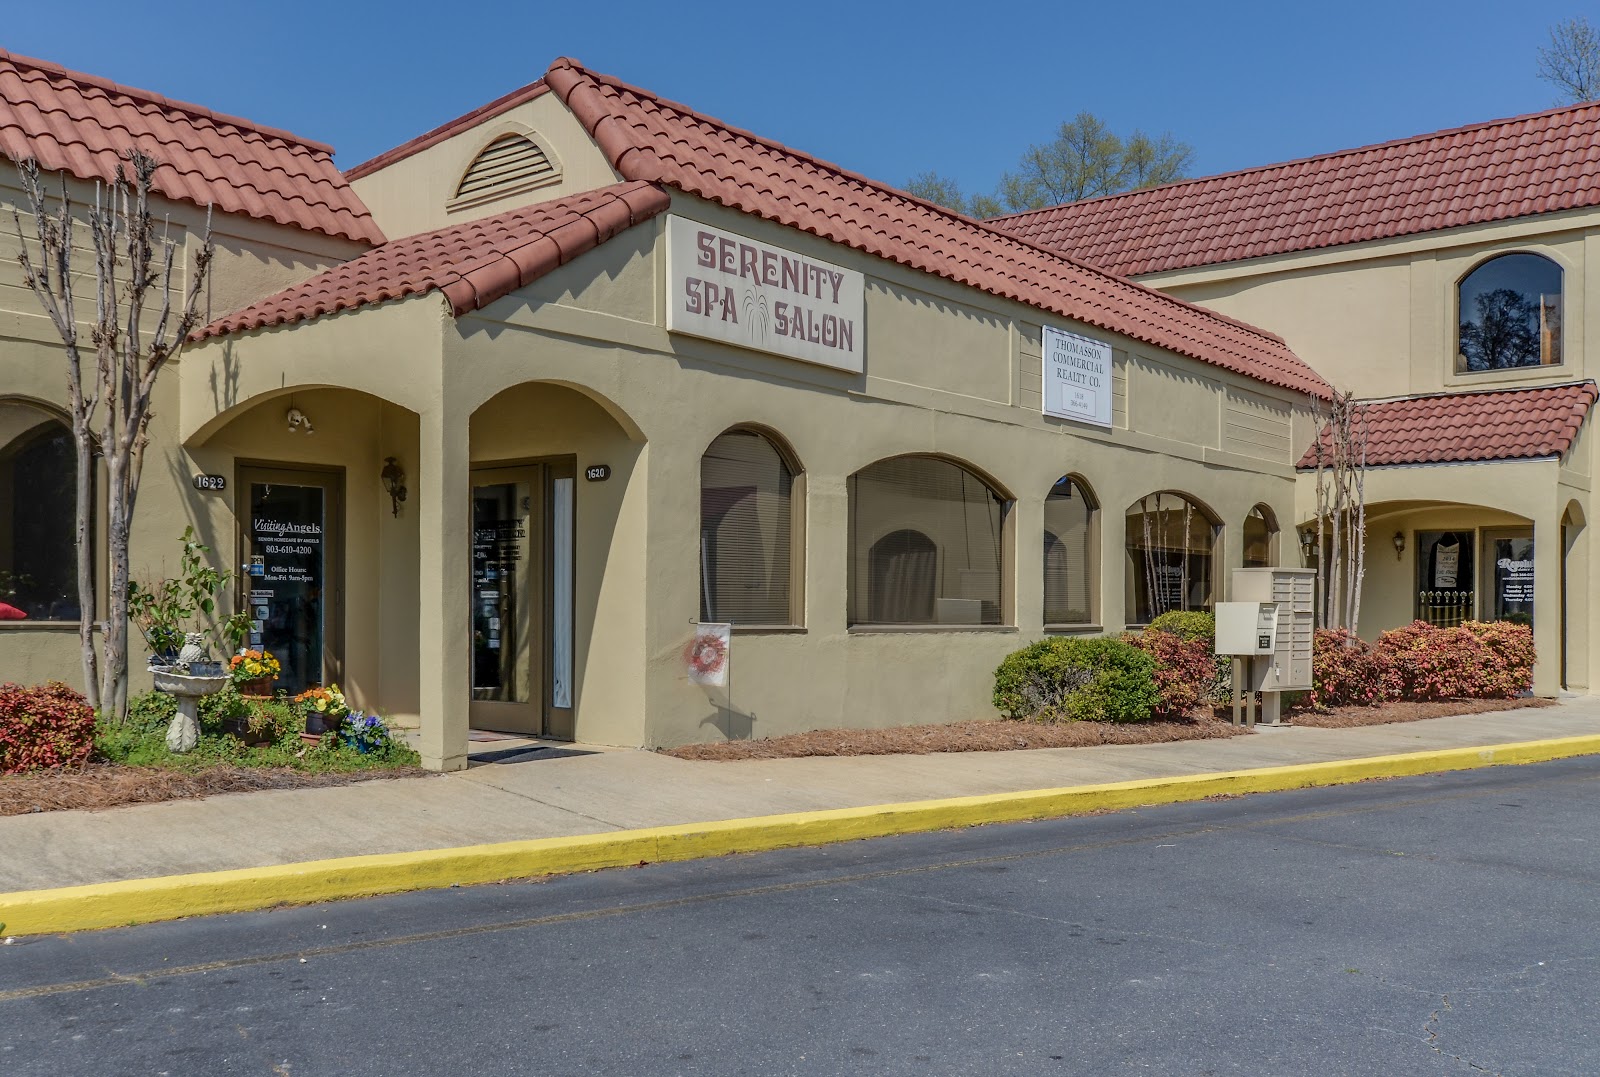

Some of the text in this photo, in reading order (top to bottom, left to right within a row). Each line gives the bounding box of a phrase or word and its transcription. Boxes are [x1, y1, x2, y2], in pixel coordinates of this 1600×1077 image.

[697, 230, 844, 304] SERENITY
[685, 276, 854, 352] SPA SALON
[1055, 338, 1102, 360] THOMASSON
[1052, 351, 1104, 374] COMMERCIAL
[1056, 367, 1101, 388] REALTY CO.
[198, 476, 224, 489] 1622
[588, 467, 605, 479] 1620
[254, 518, 286, 537] Visiting
[265, 545, 312, 554] 803-610-4200
